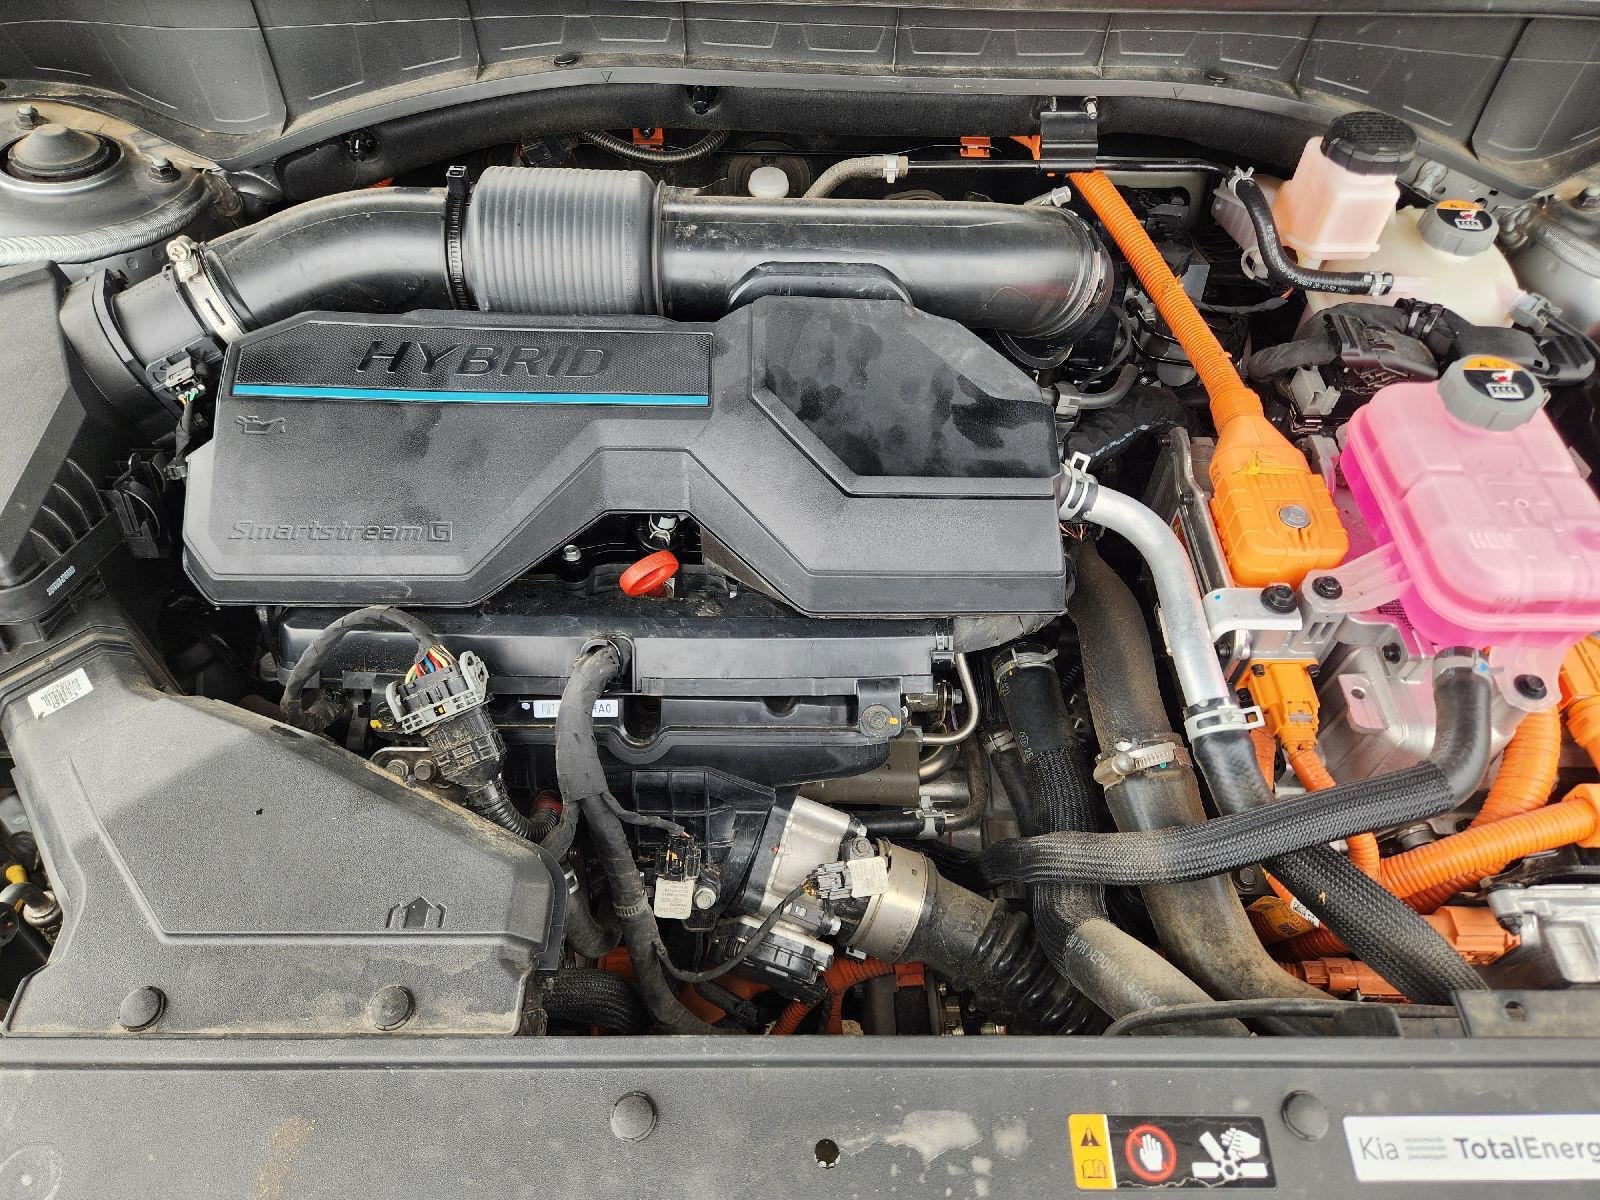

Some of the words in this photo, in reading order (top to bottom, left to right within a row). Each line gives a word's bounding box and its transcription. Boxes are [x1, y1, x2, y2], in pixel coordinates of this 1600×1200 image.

[356, 340, 613, 378] HYBRID
[228, 521, 423, 541] Smartstream
[1359, 1136, 1399, 1161] Kia
[1454, 1136, 1600, 1163] TotalEnerg
